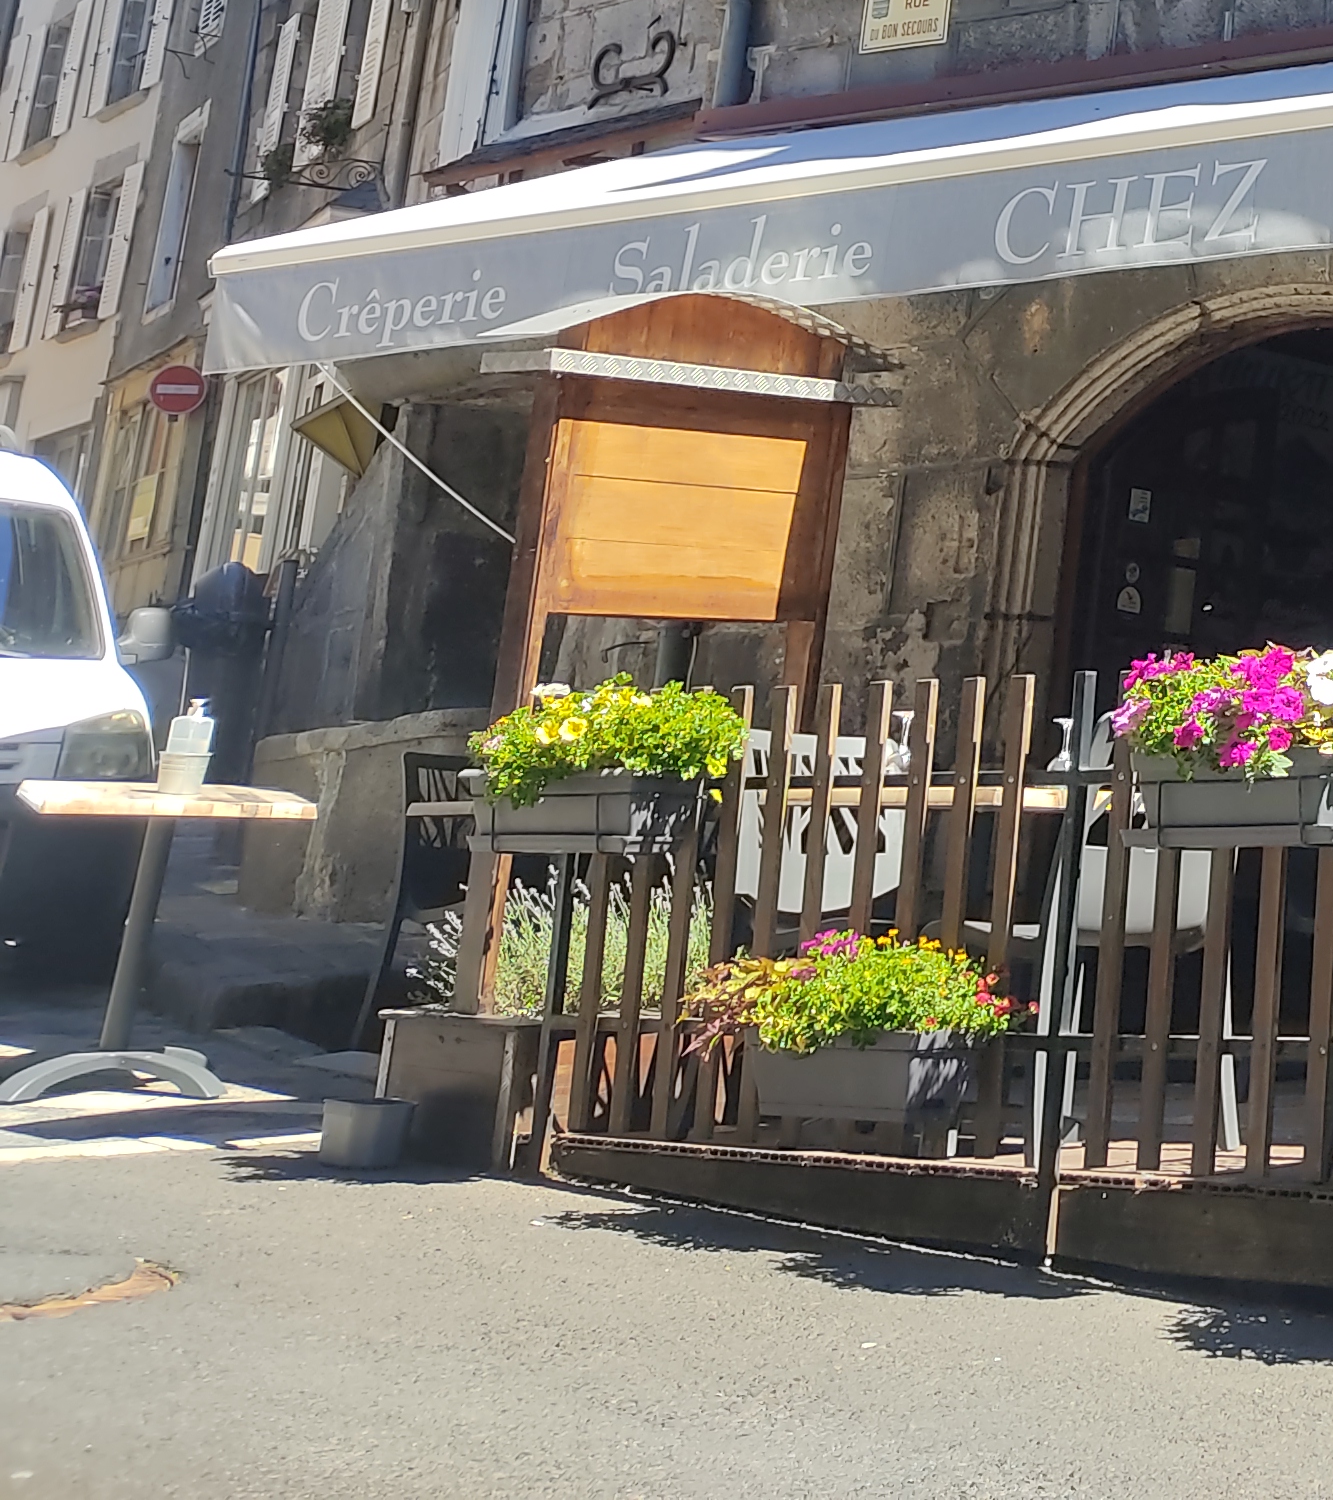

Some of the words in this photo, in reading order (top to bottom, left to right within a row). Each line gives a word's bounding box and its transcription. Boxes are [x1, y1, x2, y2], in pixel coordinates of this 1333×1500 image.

[870, 28, 880, 41] DU
[882, 23, 898, 40] BON
[901, 18, 939, 37] SECOURS
[298, 267, 507, 347] Crêperie
[608, 213, 874, 300] Saladerie
[994, 158, 1268, 266] CHEZ
